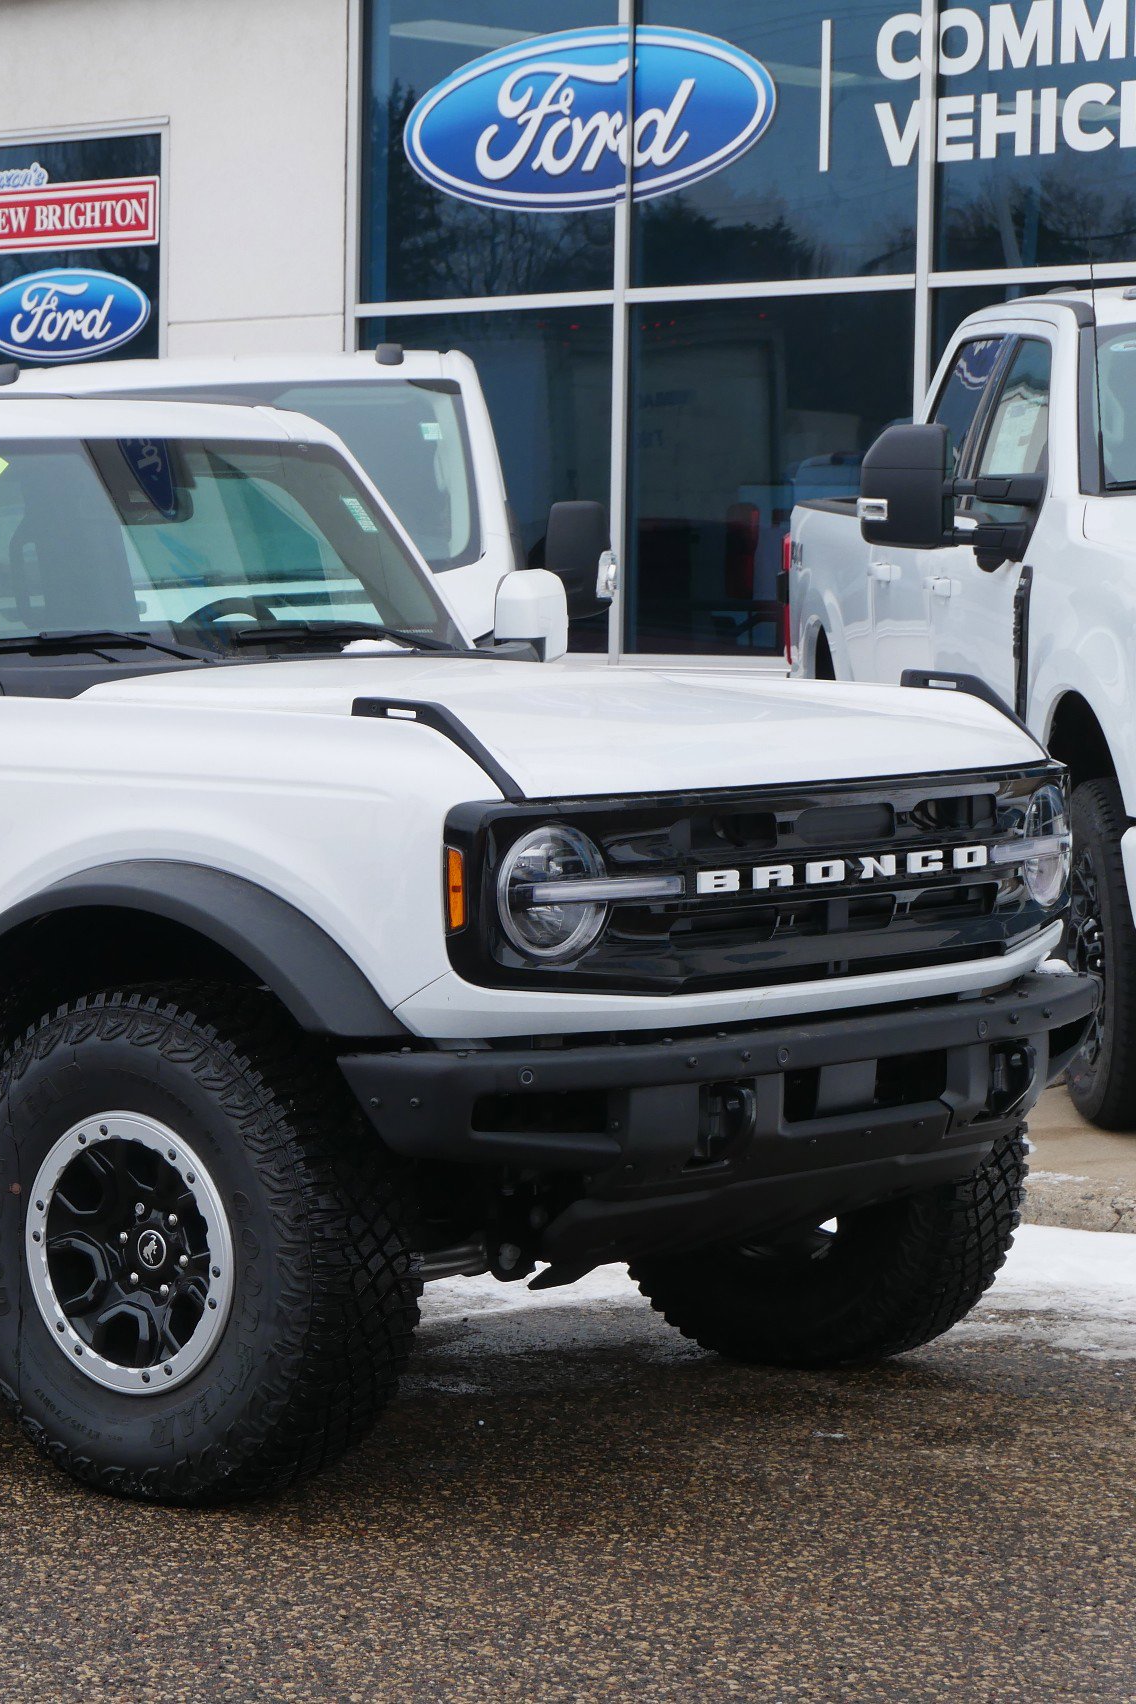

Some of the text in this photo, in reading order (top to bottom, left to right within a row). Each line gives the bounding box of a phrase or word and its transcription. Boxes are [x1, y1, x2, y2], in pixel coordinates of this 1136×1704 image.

[876, 0, 1136, 80] COMM
[475, 58, 696, 180] Ford
[34, 198, 147, 232] BRIGHTON
[10, 281, 115, 343] Ford
[696, 845, 988, 894] BRONCO
